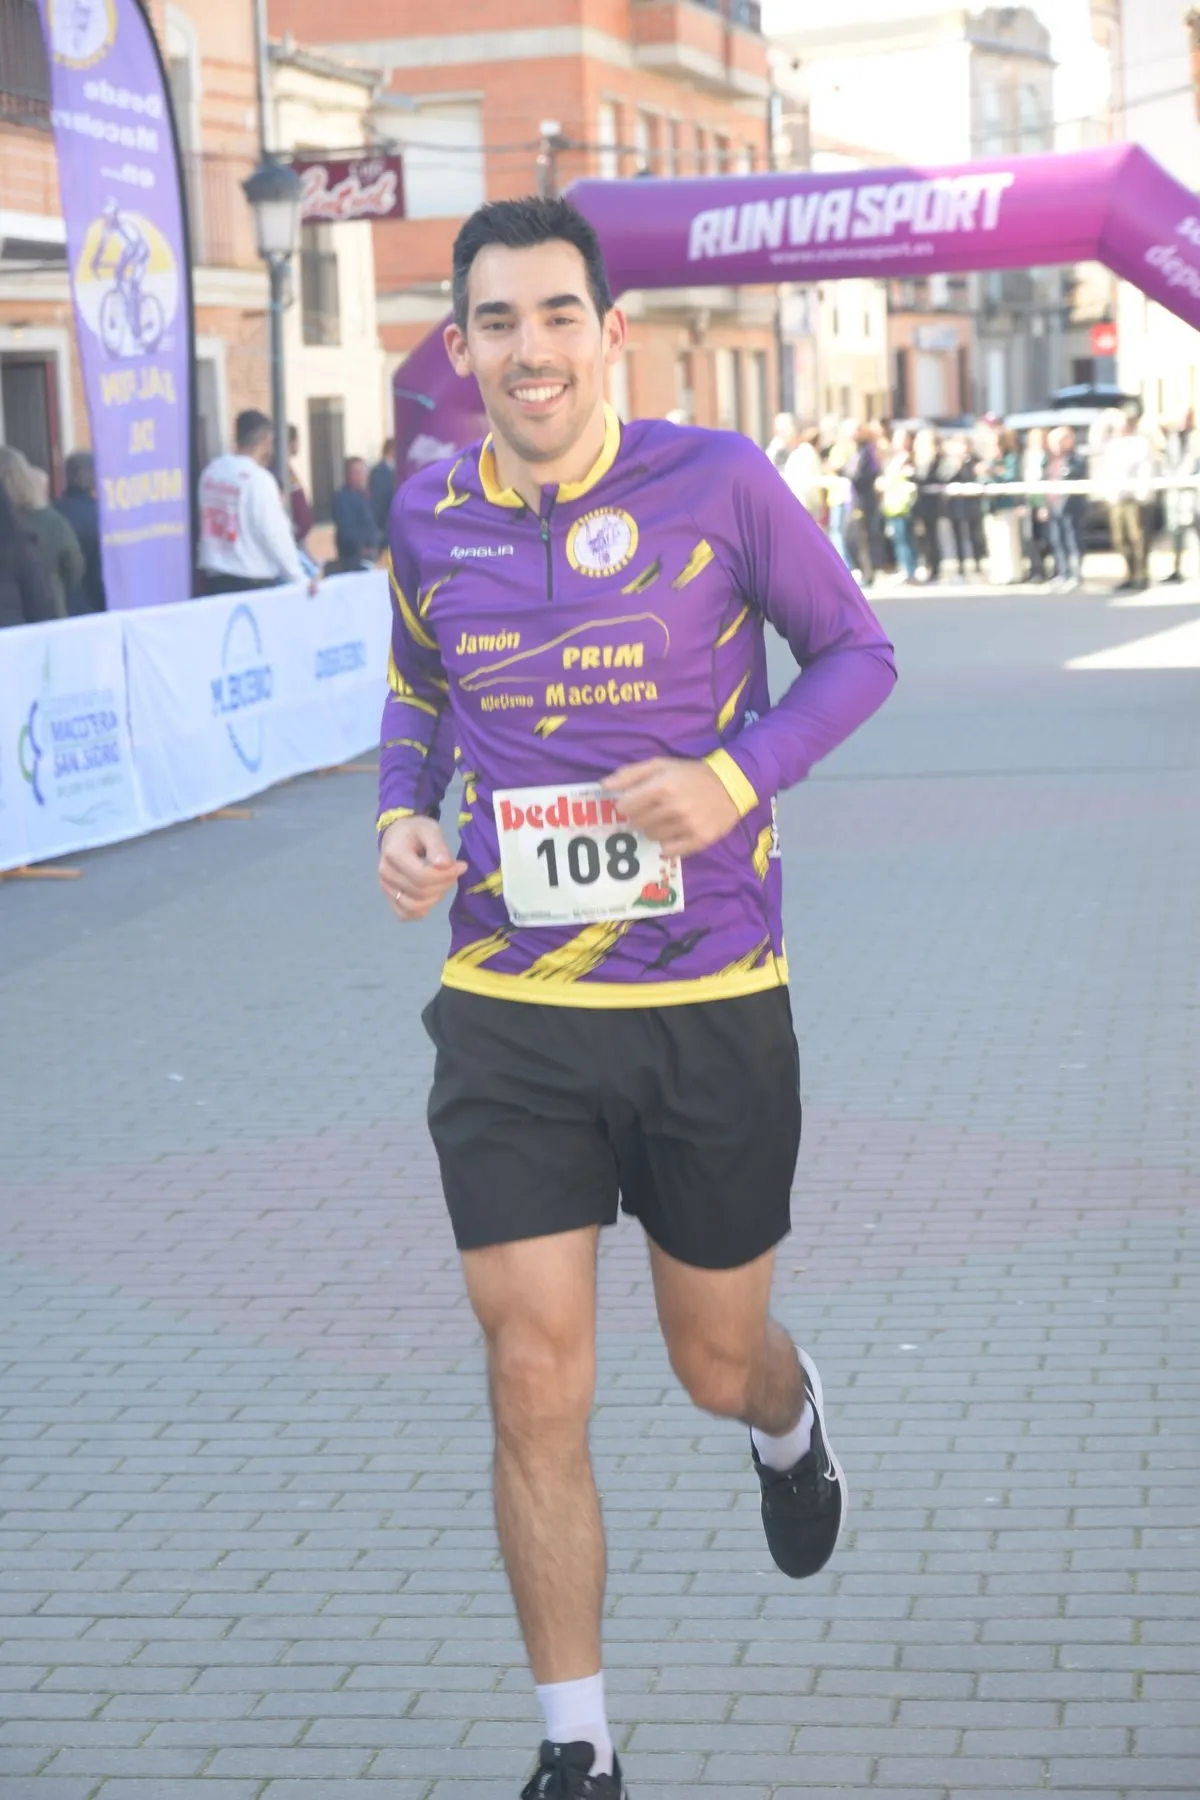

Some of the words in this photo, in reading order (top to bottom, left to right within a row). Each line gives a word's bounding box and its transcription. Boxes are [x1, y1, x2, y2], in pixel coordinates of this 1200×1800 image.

[688, 172, 1014, 261] RUNVASPORT
[456, 628, 520, 655] Jamón
[562, 641, 645, 671] PRIM
[480, 692, 534, 712] Atletismo
[546, 679, 658, 709] Macotera
[537, 832, 641, 889] 108
